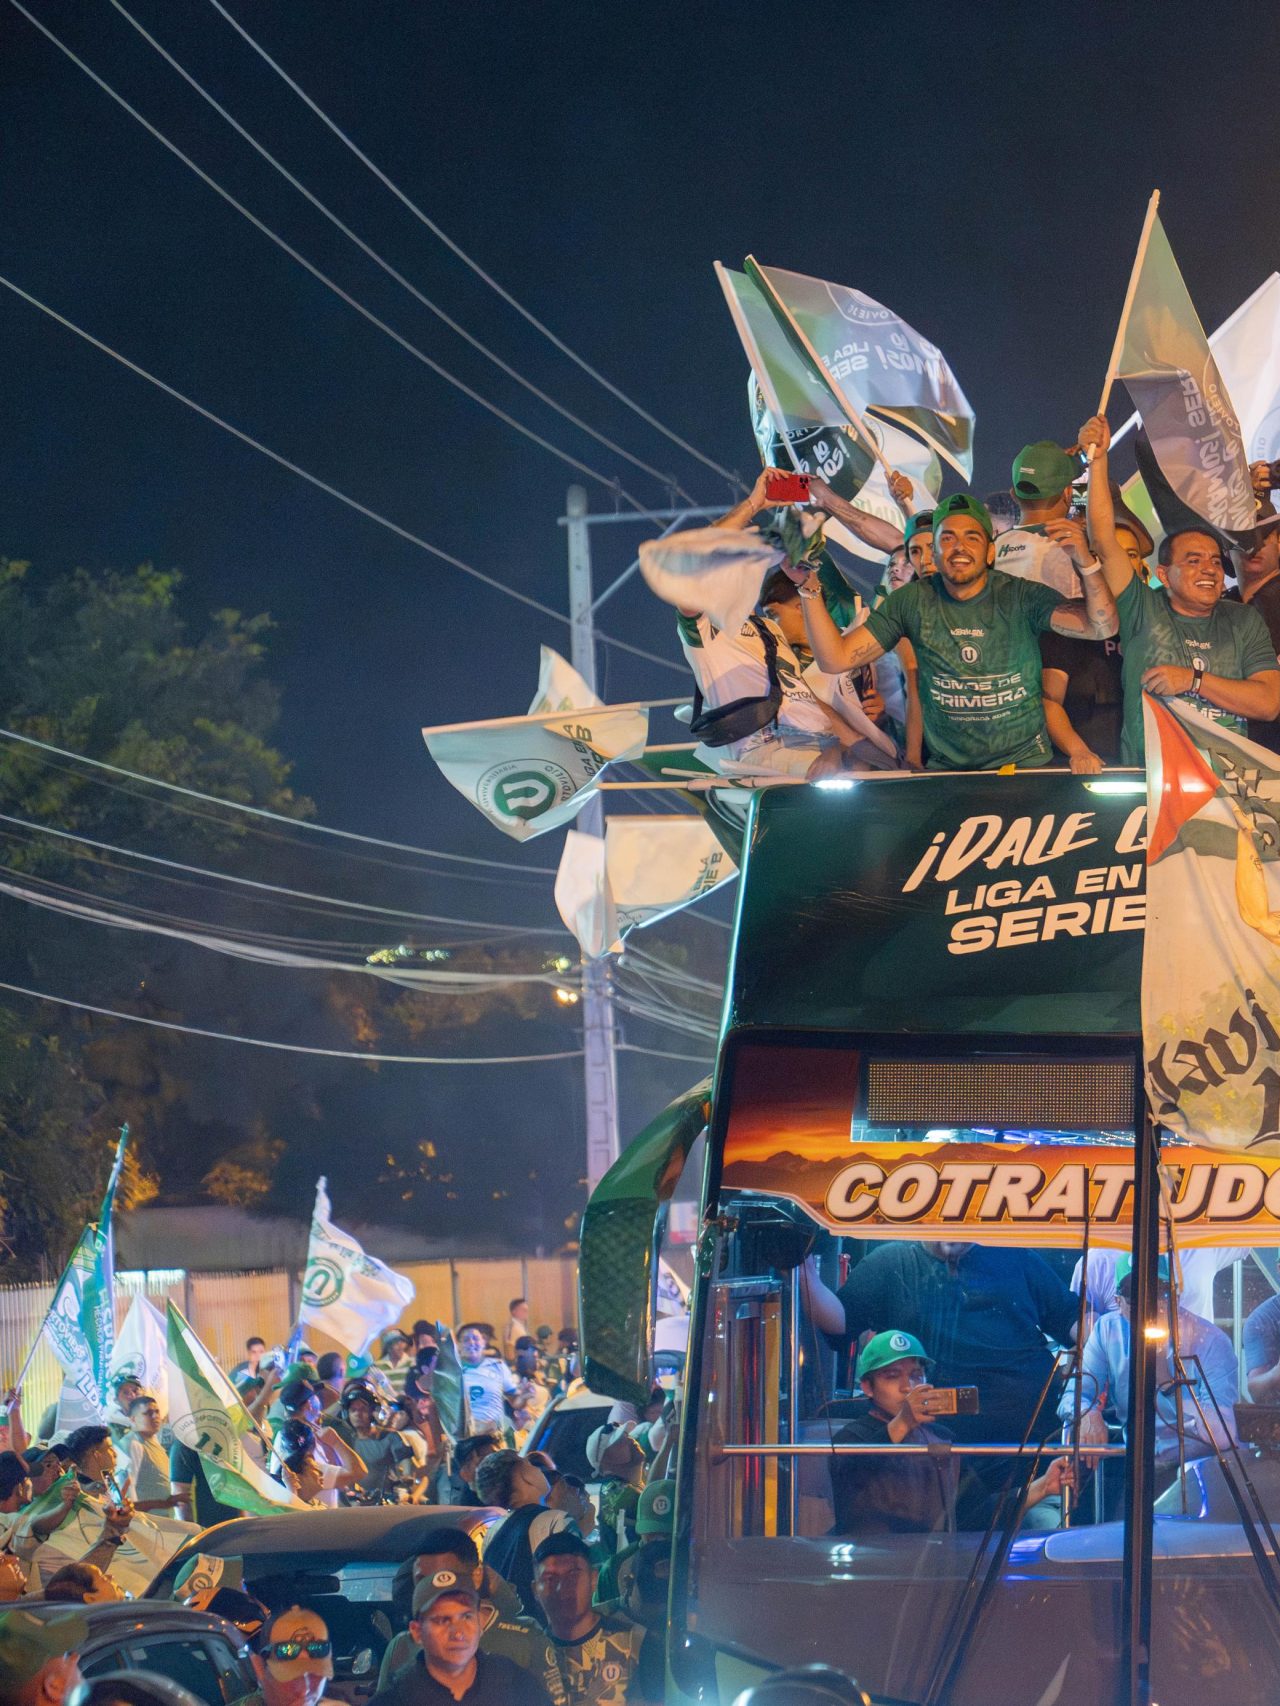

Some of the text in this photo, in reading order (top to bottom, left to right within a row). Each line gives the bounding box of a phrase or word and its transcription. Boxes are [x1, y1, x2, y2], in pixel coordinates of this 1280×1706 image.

[930, 686, 1028, 708] PRIMERA
[932, 672, 1022, 691] SOMOS DE
[502, 779, 550, 811] U
[902, 811, 1099, 893] ¡DALE
[944, 863, 1143, 916] LIGA EN
[947, 894, 1146, 955] SERIE
